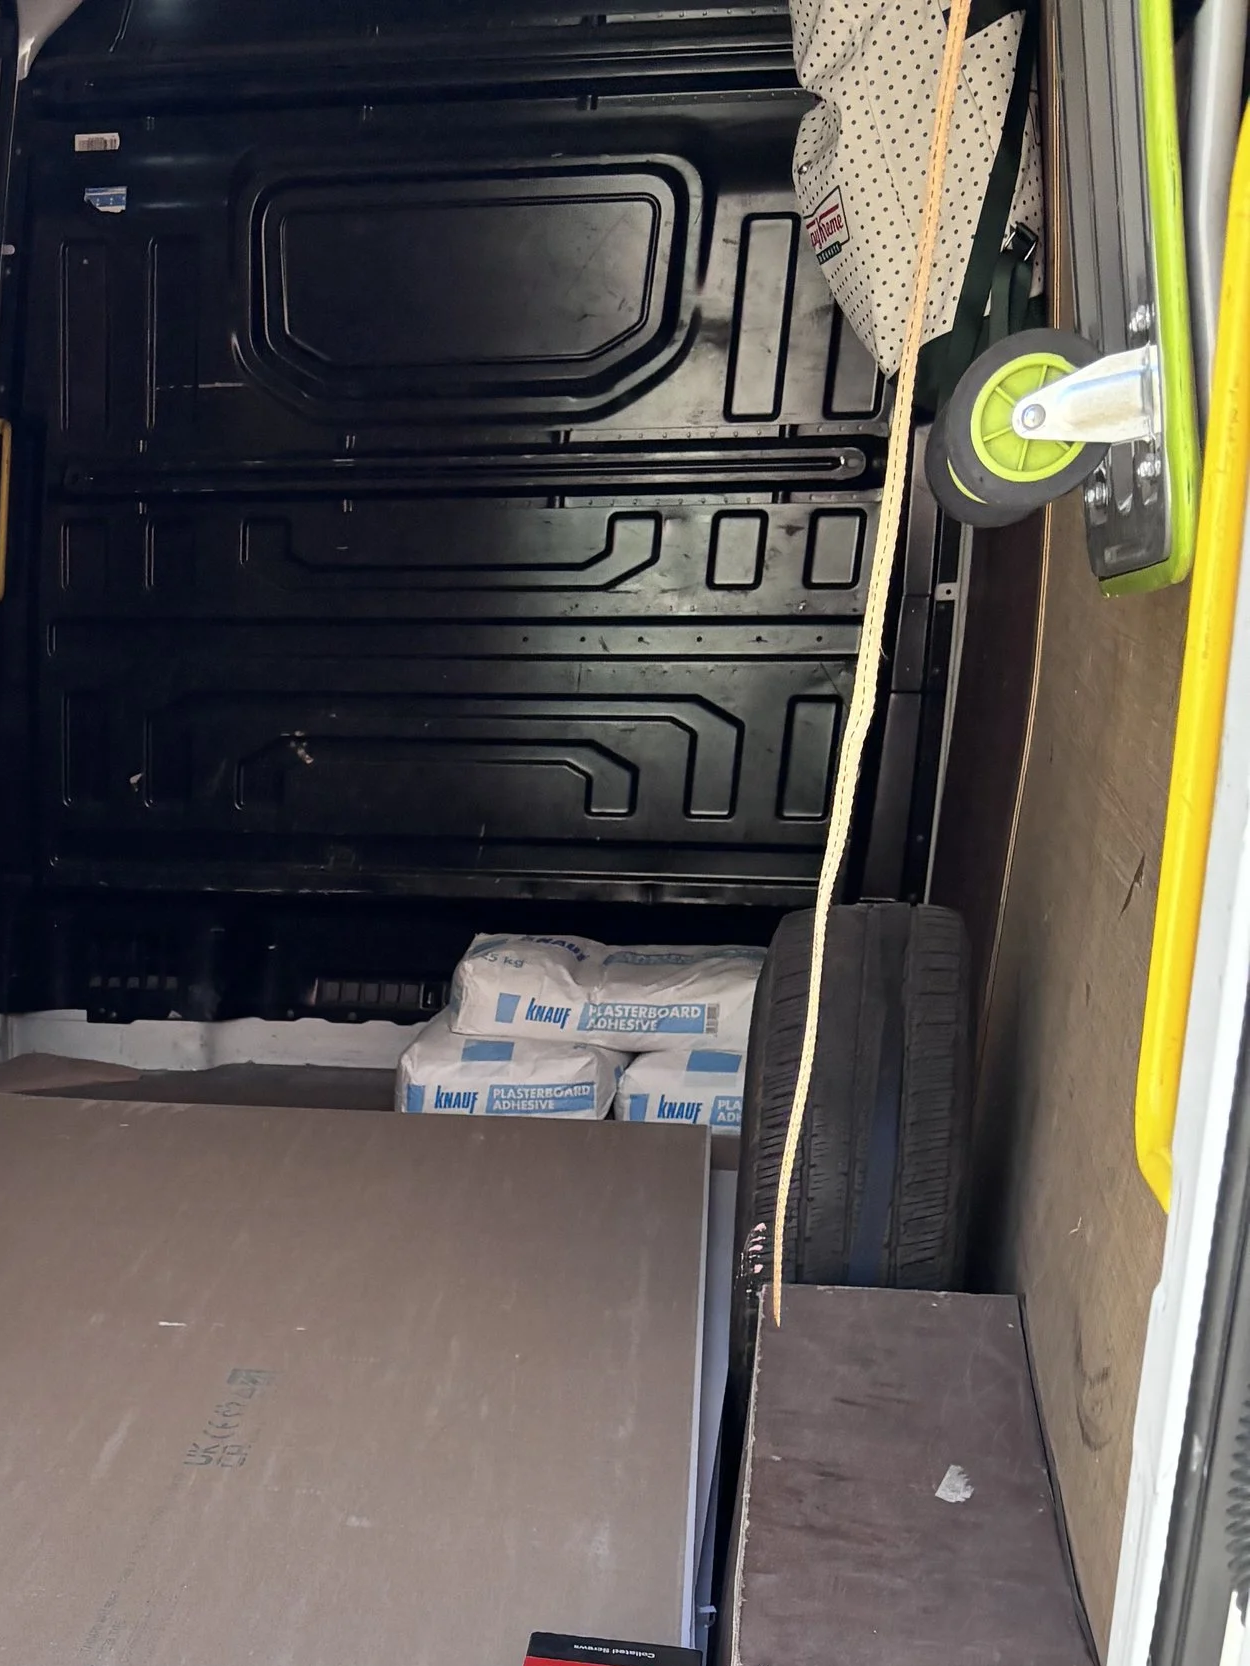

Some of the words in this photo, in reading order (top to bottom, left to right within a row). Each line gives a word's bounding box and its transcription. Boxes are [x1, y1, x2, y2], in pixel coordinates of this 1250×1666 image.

[502, 956, 525, 969] kg
[525, 997, 571, 1030] KNAUF
[588, 1003, 702, 1020] PLASTERBOARD
[585, 1017, 659, 1032] ADHESIVE
[492, 1085, 591, 1099] PLASTERBOARD
[434, 1085, 478, 1114] KNAUF
[492, 1099, 555, 1111] ADHESIVE
[657, 1094, 703, 1124] KNAUF
[573, 1643, 610, 1654] Screws
[612, 1647, 656, 1659] Collated
